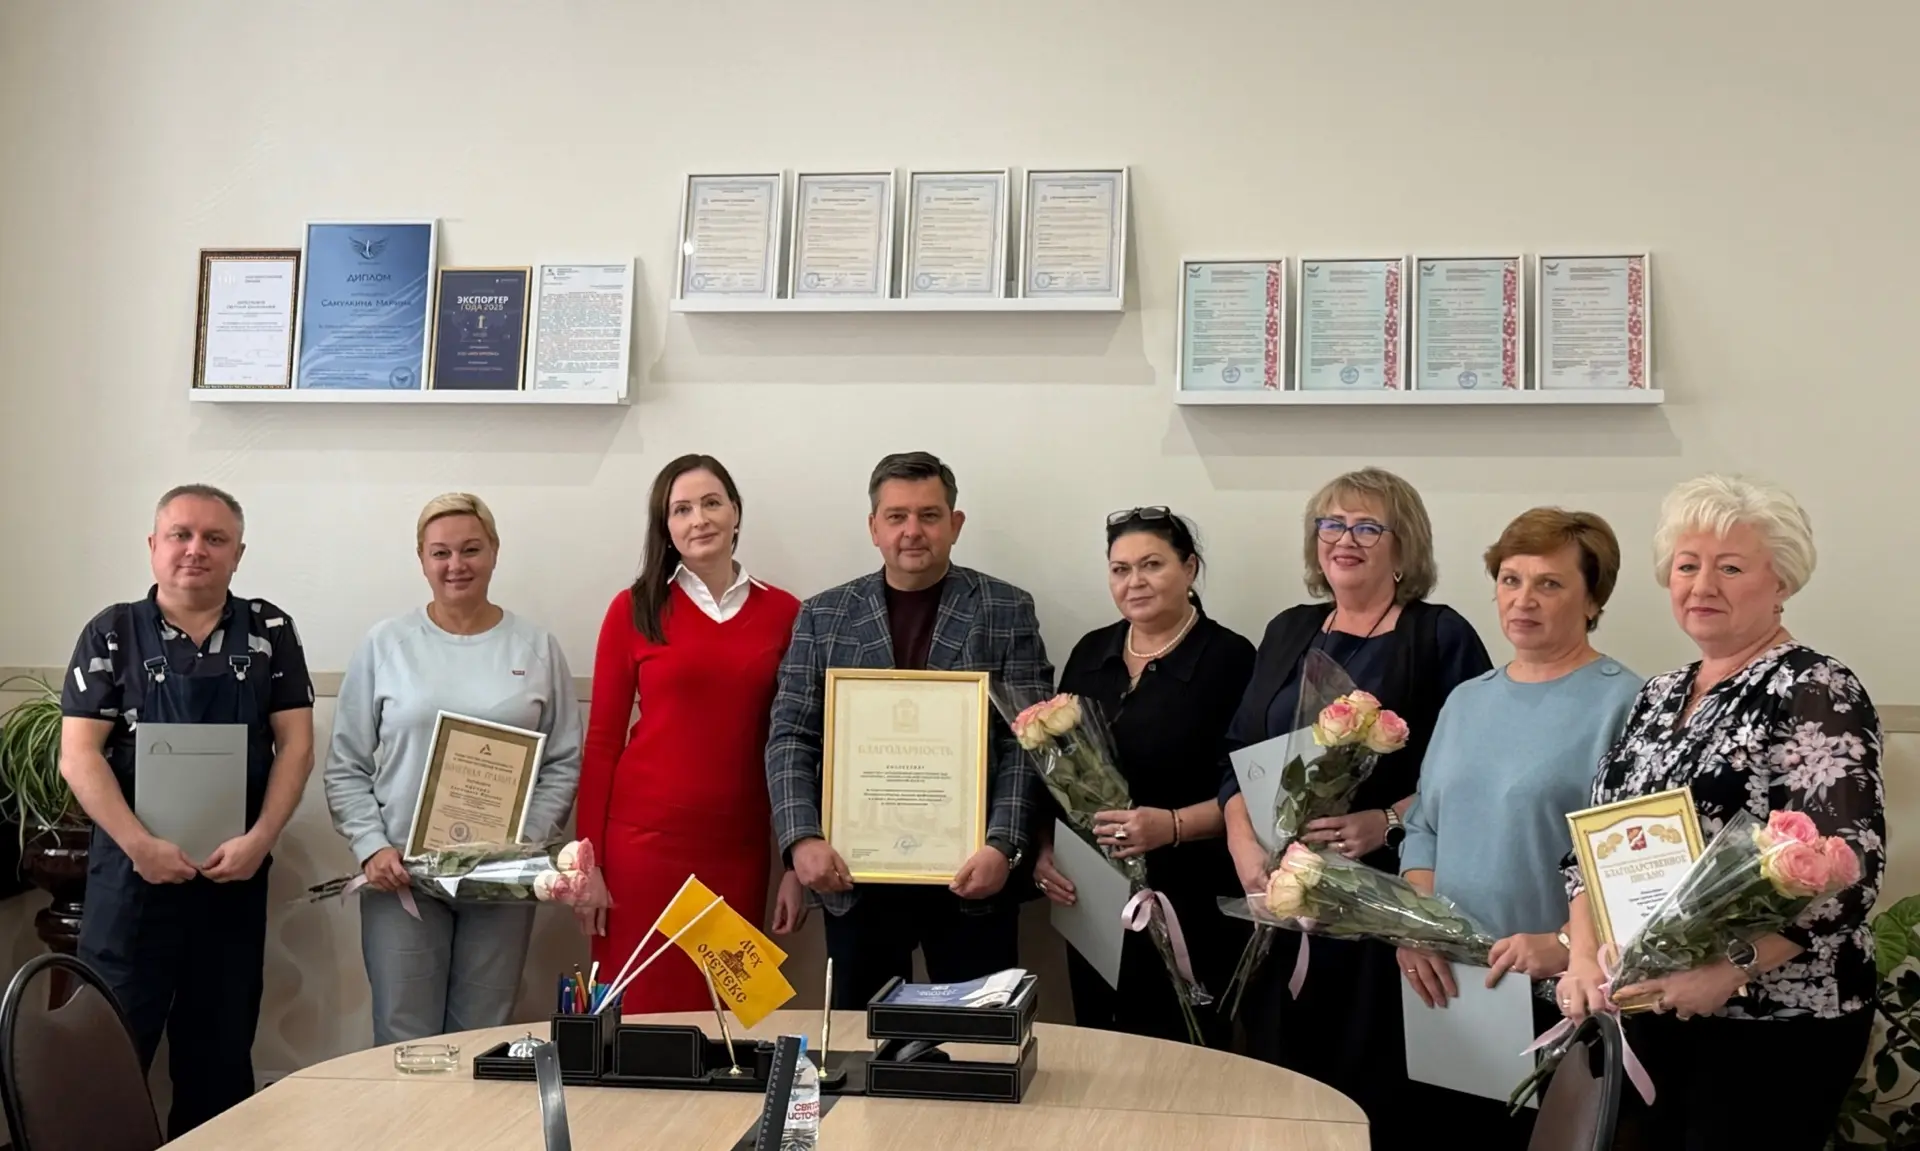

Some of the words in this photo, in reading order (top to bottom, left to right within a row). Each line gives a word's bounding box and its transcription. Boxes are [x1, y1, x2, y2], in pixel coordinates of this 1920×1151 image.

[346, 273, 391, 283] ДИПЛОМ
[456, 295, 509, 304] ЭКСПОРТЕР
[460, 303, 482, 312] ГОДА
